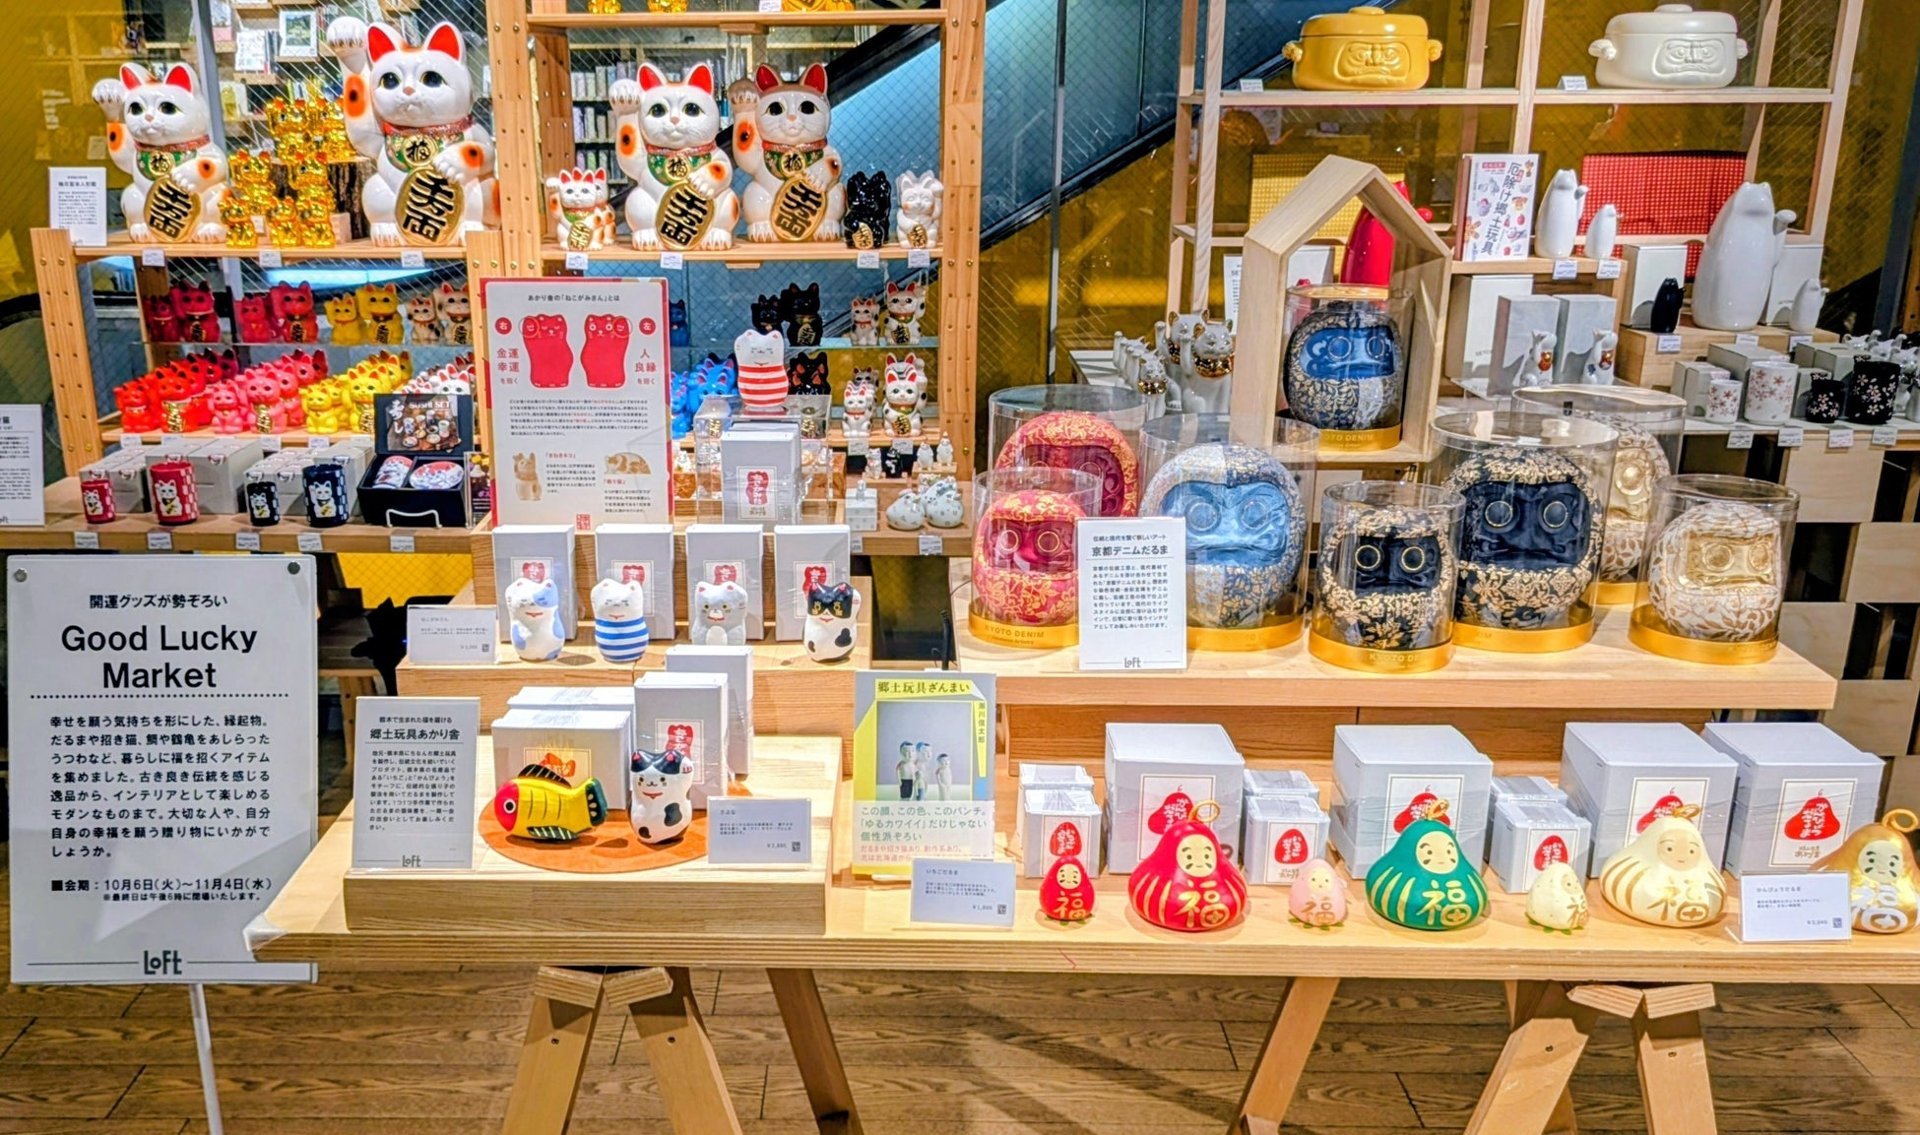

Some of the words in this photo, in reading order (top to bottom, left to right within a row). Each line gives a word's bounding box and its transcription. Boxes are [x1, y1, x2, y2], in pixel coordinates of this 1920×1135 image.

[496, 348, 520, 359] 金運
[497, 362, 521, 373] 幸運
[635, 362, 657, 373] 良縁
[1091, 545, 1169, 557] 京都デニムだるま
[89, 594, 228, 609] 開運グッズが勢ぞろい
[61, 625, 148, 651] Good
[160, 625, 258, 653] Lucky
[1014, 630, 1045, 638] DENIM
[103, 662, 217, 688] Market
[877, 680, 970, 694] 郷土玩具ざんまい
[50, 714, 267, 728] 幸せを願う気持ちを形にした、縁起物。
[50, 734, 270, 746] だるまや招き猫、鯛や鶴亀をあしらった
[369, 728, 460, 740] 郷土玩具あかり舎
[50, 752, 270, 765] うつわなど、暮らしに福を招くアイテム
[51, 771, 270, 783] を集めました。古き良き伝統を感じる
[50, 789, 270, 802] 逸品から、インテリアとして楽しめる
[51, 807, 271, 820] モダンなものまで。大切な人や、自分
[861, 806, 986, 817] この顔、この色、このパンチ。
[861, 819, 987, 829] 「ゆるカワイイ」だけじゃない
[51, 826, 271, 839] 自身の幸福を願う贈り物にいかがで
[860, 832, 922, 841] 個性派ぞろい
[51, 846, 112, 858] しょうか。
[1052, 890, 1086, 919] 福
[1174, 879, 1230, 927] 福
[1416, 879, 1473, 926] 福
[1301, 895, 1336, 924] 福
